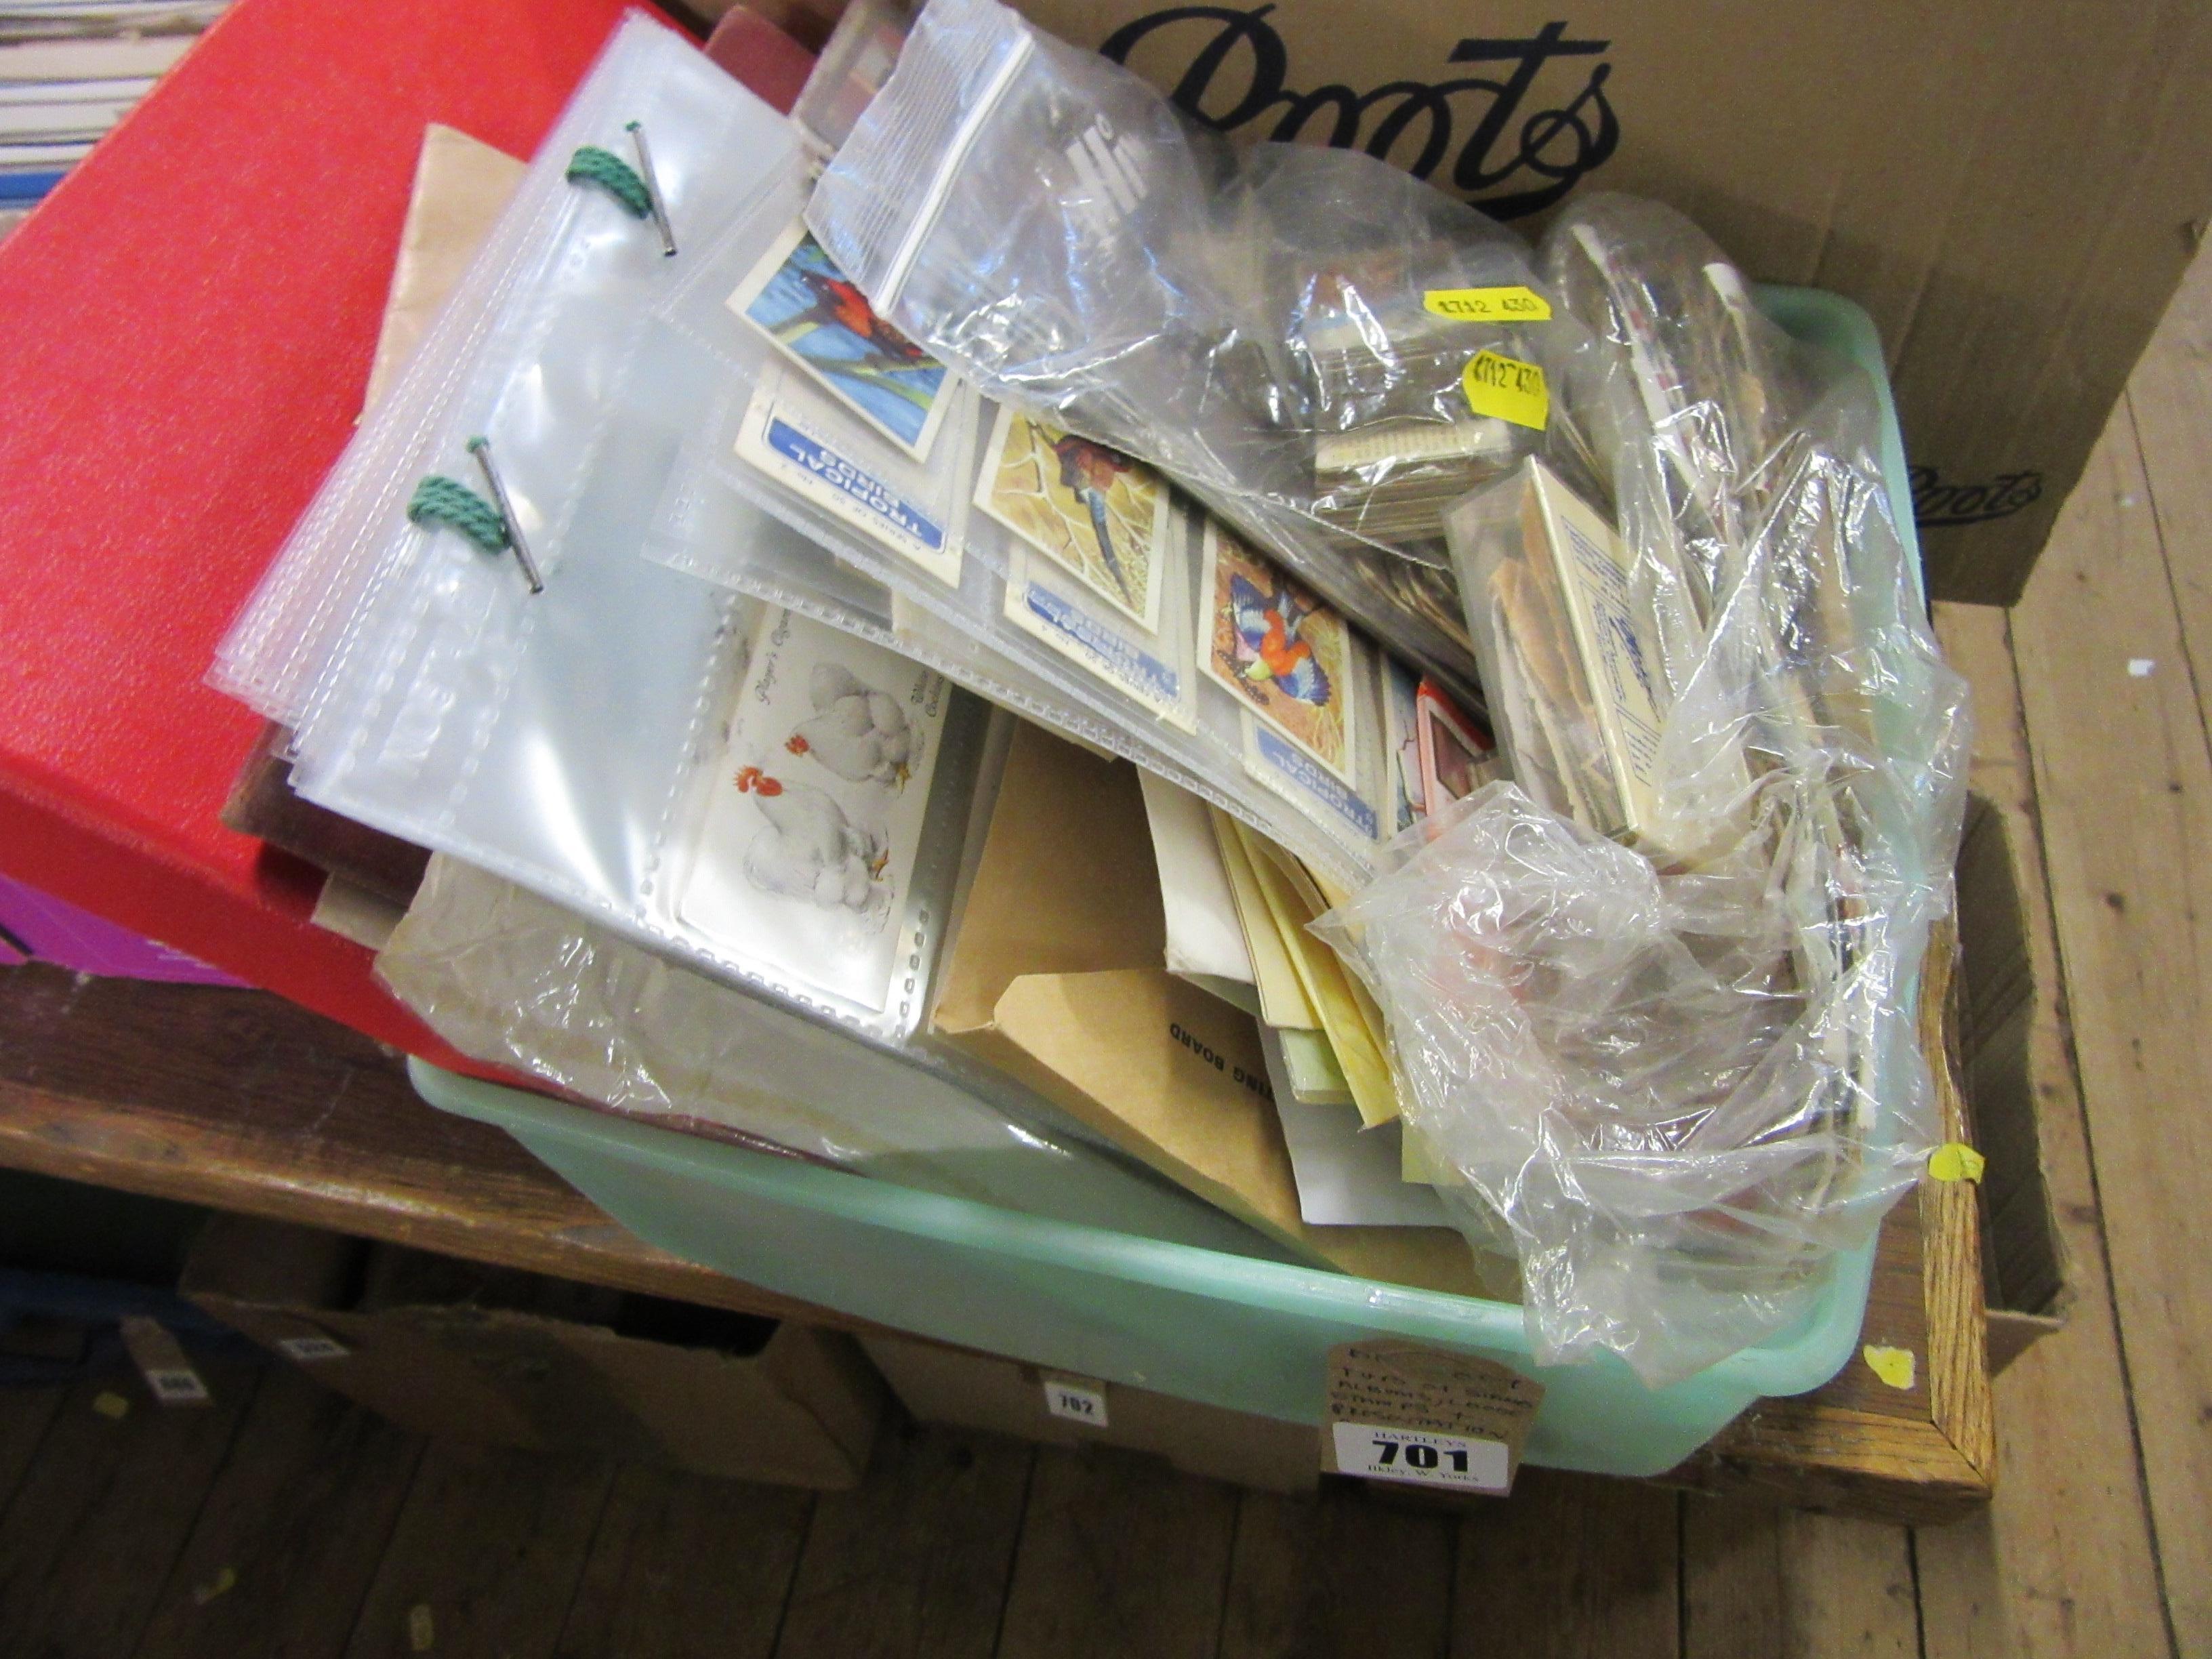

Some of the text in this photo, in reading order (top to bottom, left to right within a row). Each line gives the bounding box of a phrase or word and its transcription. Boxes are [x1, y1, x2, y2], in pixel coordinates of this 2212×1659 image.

[790, 444, 922, 538] TROPICAL
[819, 449, 901, 508] BIRDS
[1170, 1023, 1225, 1071] BOARD
[1372, 1439, 1469, 1473] 701
[1374, 1431, 1467, 1448] HARTLEYS
